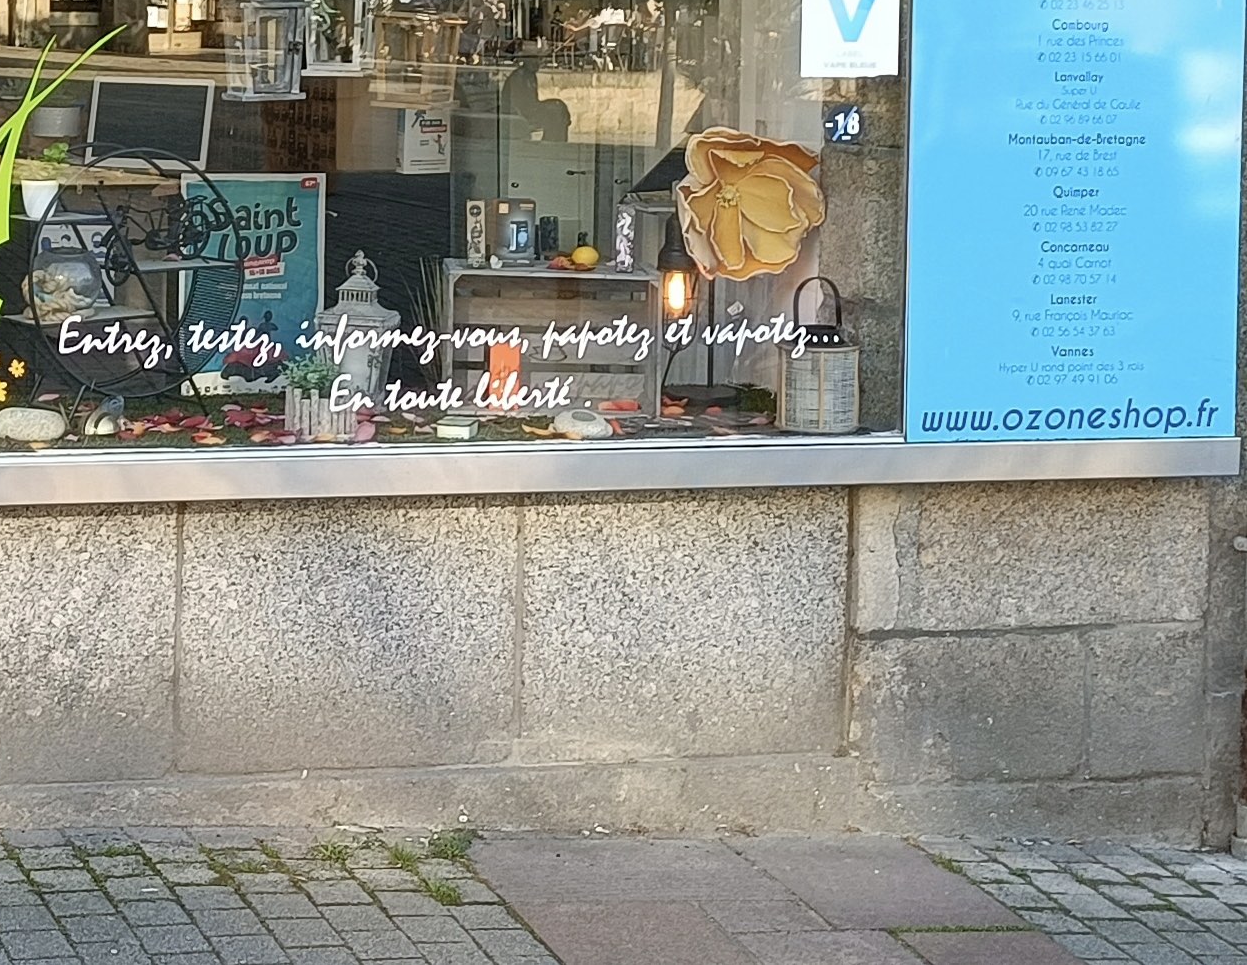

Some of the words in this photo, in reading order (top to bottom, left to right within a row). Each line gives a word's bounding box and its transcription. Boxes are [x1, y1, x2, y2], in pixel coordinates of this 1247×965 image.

[1052, 18, 1109, 33] Combourg
[1046, 38, 1063, 46] rue
[1066, 35, 1085, 46] des
[1089, 35, 1124, 46] Princes
[1054, 71, 1104, 83] Lanvallay
[1008, 133, 1146, 146] Montauban-de-Bretagne
[1056, 153, 1071, 161] rue
[1075, 150, 1089, 161] de
[1093, 149, 1117, 161] Brest
[1053, 186, 1099, 198] Quimper
[1023, 204, 1038, 216] 20
[1041, 207, 1057, 216] rue
[1041, 241, 1109, 252] Concarneau
[1050, 294, 1097, 305] Lanester
[58, 315, 172, 368] Entrez,
[186, 319, 283, 368] testez,
[299, 315, 529, 365] informez-vous,
[542, 315, 655, 361] papotez
[664, 318, 693, 344] et
[702, 314, 840, 358] vapotez...
[1051, 346, 1094, 356] Vannes
[1037, 375, 1050, 385] 02
[1054, 375, 1067, 385] 97
[1071, 375, 1084, 385] 49
[1088, 375, 1099, 385] 91
[1104, 375, 1117, 385] 06
[329, 375, 375, 412] En
[384, 377, 462, 412] toute
[473, 372, 573, 411] liberté
[921, 398, 1219, 434] www.ozoneshop.fr
